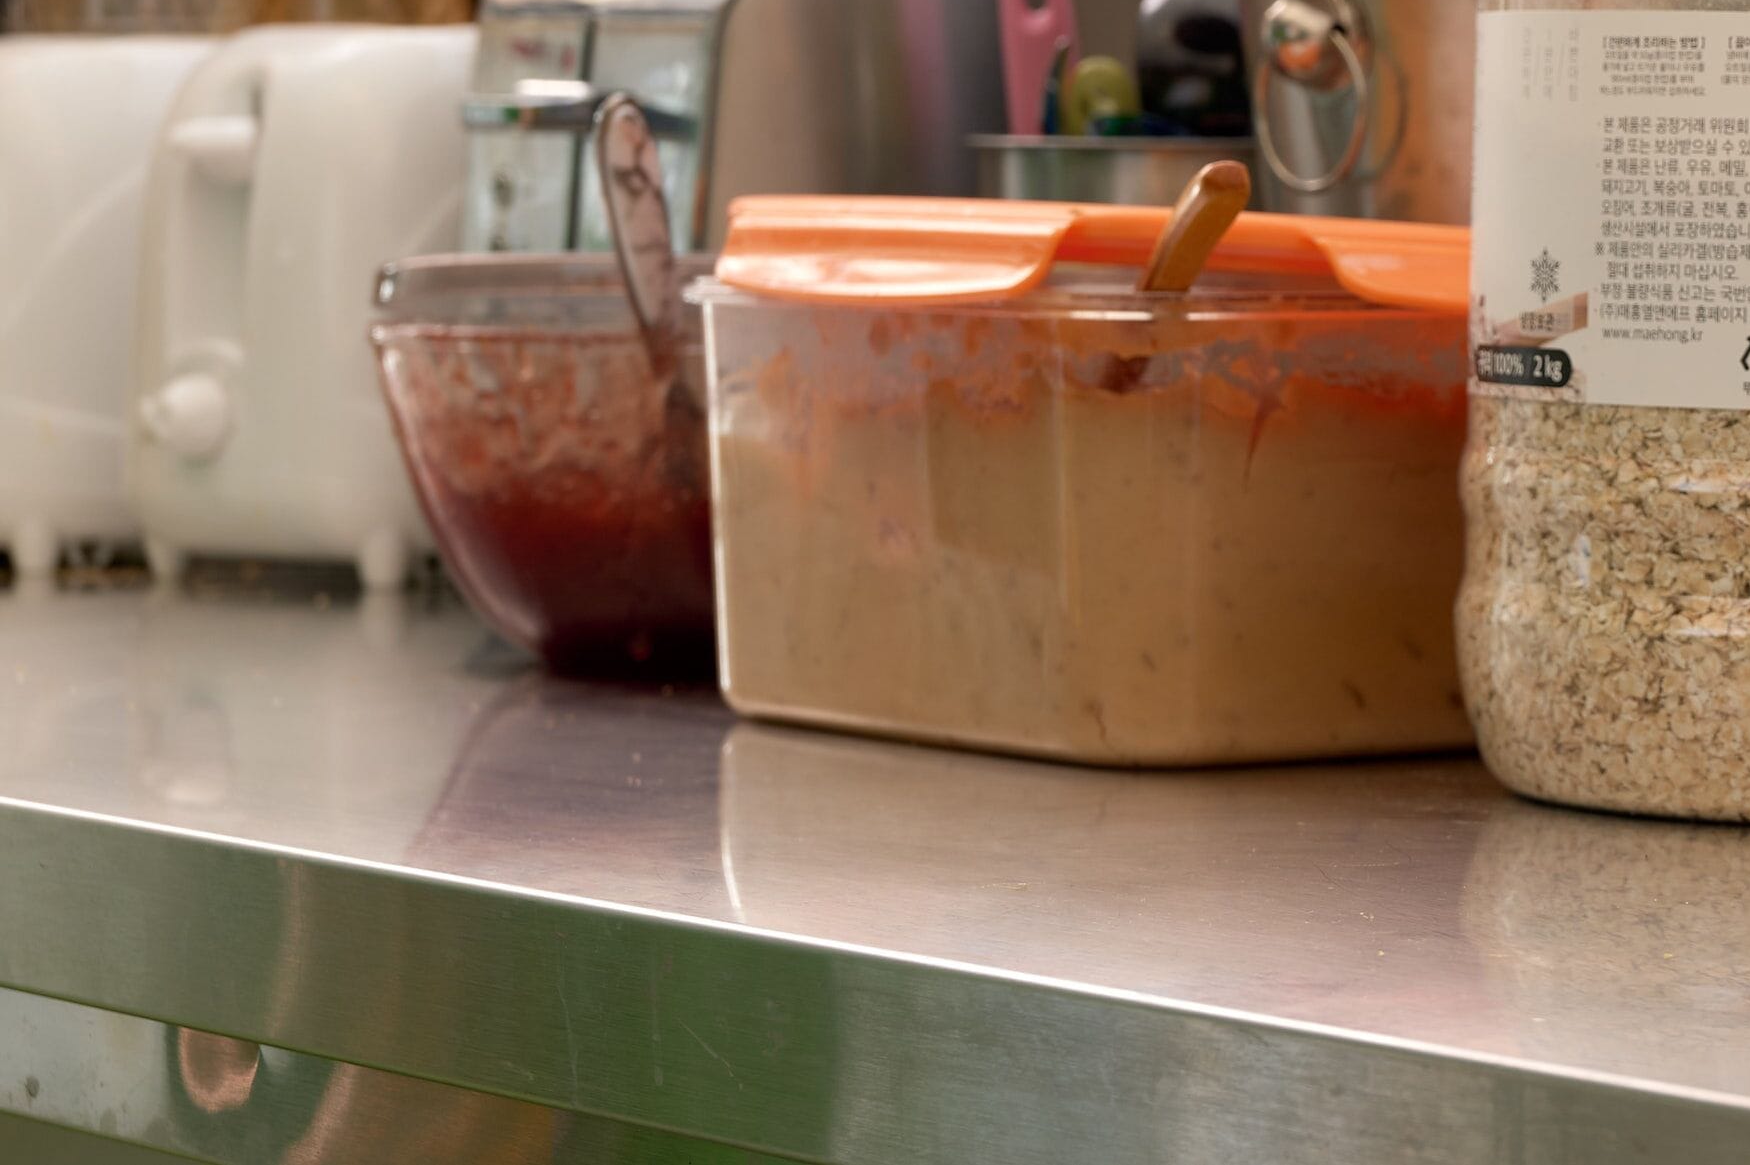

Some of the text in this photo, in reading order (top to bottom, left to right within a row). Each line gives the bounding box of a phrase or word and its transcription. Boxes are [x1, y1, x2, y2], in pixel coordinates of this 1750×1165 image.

[1618, 116, 1651, 135] 제품은
[1656, 116, 1706, 135] 공정거래
[1710, 117, 1750, 135] 위원회
[1603, 137, 1624, 155] 교환
[1627, 137, 1651, 155] 또는
[1655, 138, 1718, 156] 보상받으실
[1722, 139, 1734, 155] 수
[1617, 157, 1651, 176] 제품은
[1632, 262, 1681, 280] 섭취하지
[1678, 284, 1717, 302] 신고는
[1695, 305, 1749, 324] 홈페이지
